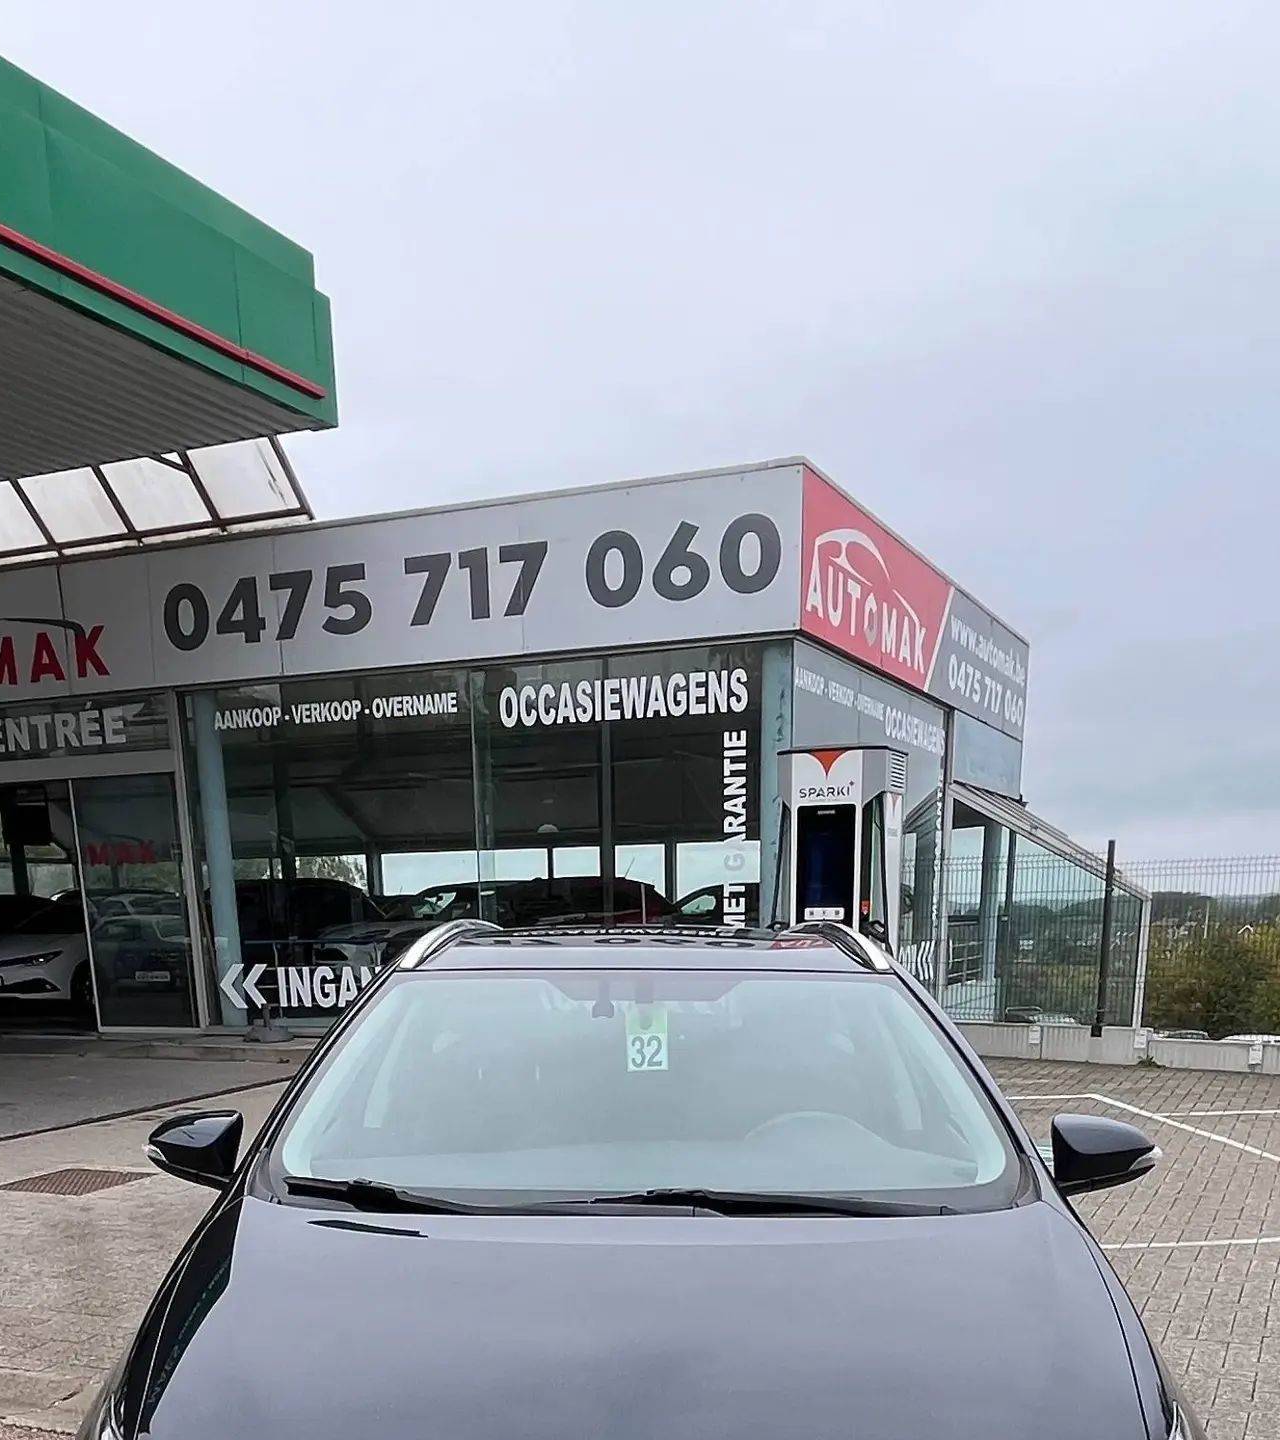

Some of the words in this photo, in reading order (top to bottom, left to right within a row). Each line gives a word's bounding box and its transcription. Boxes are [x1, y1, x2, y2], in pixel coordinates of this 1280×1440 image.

[164, 562, 372, 651] 0475
[404, 541, 548, 626] 717
[586, 513, 782, 609] 060
[806, 545, 926, 674] AUTOMAK
[951, 614, 1026, 688] www.automak.be
[214, 705, 282, 731] AANKOOP
[290, 699, 362, 724] VERKOOP
[372, 692, 458, 719] OVERNAME
[499, 668, 749, 728] OCCASIEWAGENS
[794, 666, 825, 697] AANKOOP
[828, 679, 854, 708] VERKOOP
[948, 653, 982, 704] 0475
[984, 675, 1003, 715] 717
[1004, 688, 1024, 728] 060
[885, 705, 946, 757] OCCASIEWAGENS
[723, 730, 748, 872] GARANTIE
[799, 786, 852, 799] SPARKI
[723, 883, 747, 929] MET
[630, 1034, 663, 1070] 32
